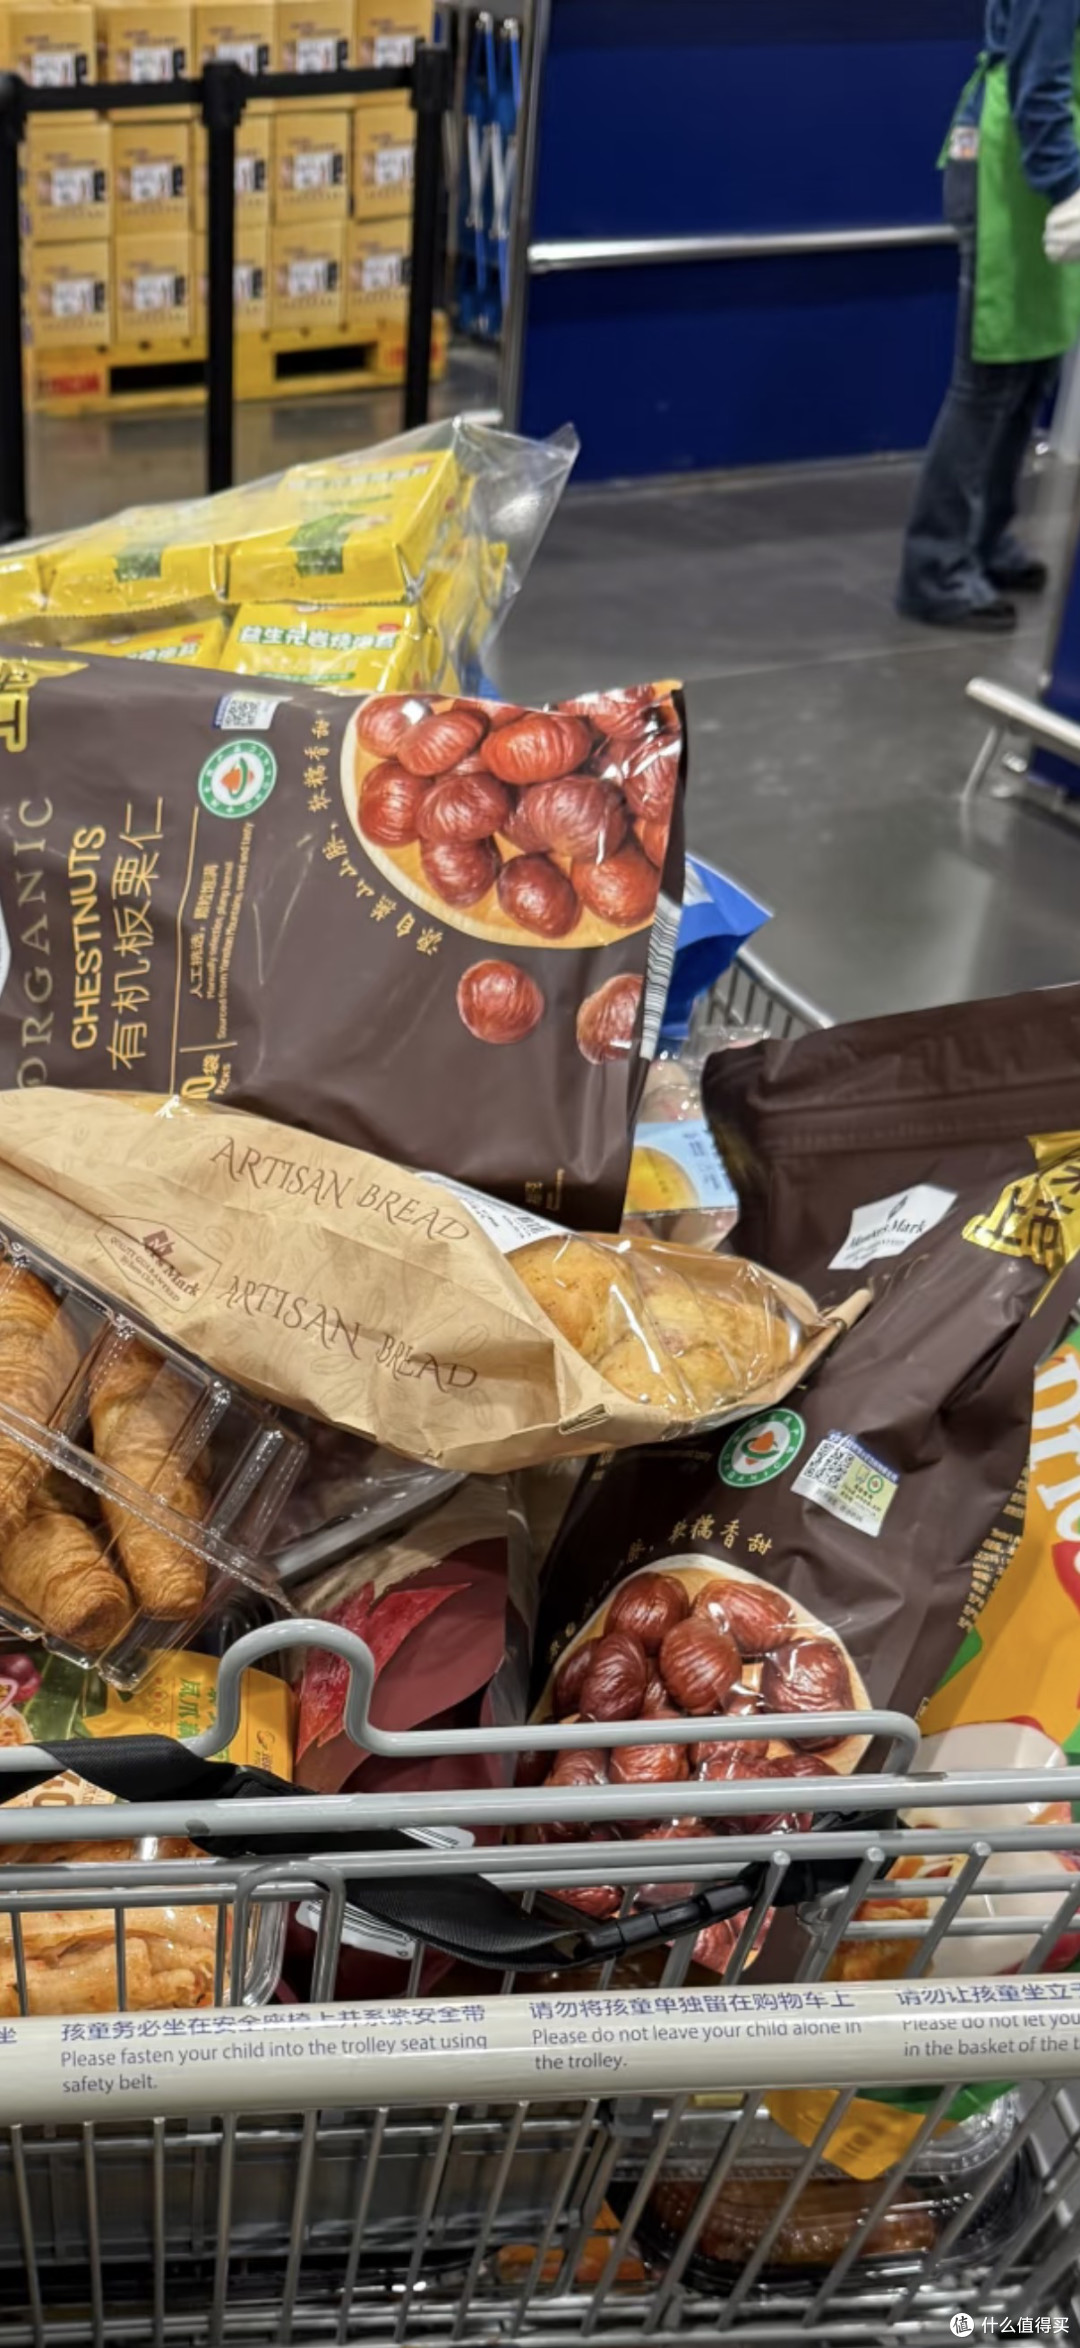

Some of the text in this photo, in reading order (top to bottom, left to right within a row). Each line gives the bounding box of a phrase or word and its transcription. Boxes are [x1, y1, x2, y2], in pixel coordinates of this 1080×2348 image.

[13, 797, 54, 1088] ORGANIC
[67, 824, 107, 1050] CHESTNUTS
[107, 797, 164, 1069] 有机板栗仁
[217, 973, 229, 998] from
[216, 998, 229, 1040] Sourced
[211, 1137, 354, 1209] ARTISAN
[356, 1183, 470, 1240] BREAD
[889, 1217, 927, 1234] Mark
[216, 1275, 478, 1393] ARTISAN BREAD
[529, 1990, 855, 2019] 请勿将孩童单独留在购物车上
[532, 2020, 861, 2045] Please do not leave your child alone in
[962, 2015, 984, 2029] do
[990, 2014, 1019, 2028] not
[1024, 2014, 1045, 2027] let
[61, 2033, 488, 2067] Please fasten your child into the trolley seat using
[904, 2042, 920, 2057] in
[925, 2040, 953, 2056] the
[958, 2038, 1015, 2055] basket
[1019, 2037, 1037, 2052] of
[1041, 2036, 1068, 2052] the
[535, 2052, 627, 2071] the trolley.
[62, 2074, 158, 2095] safety belt.
